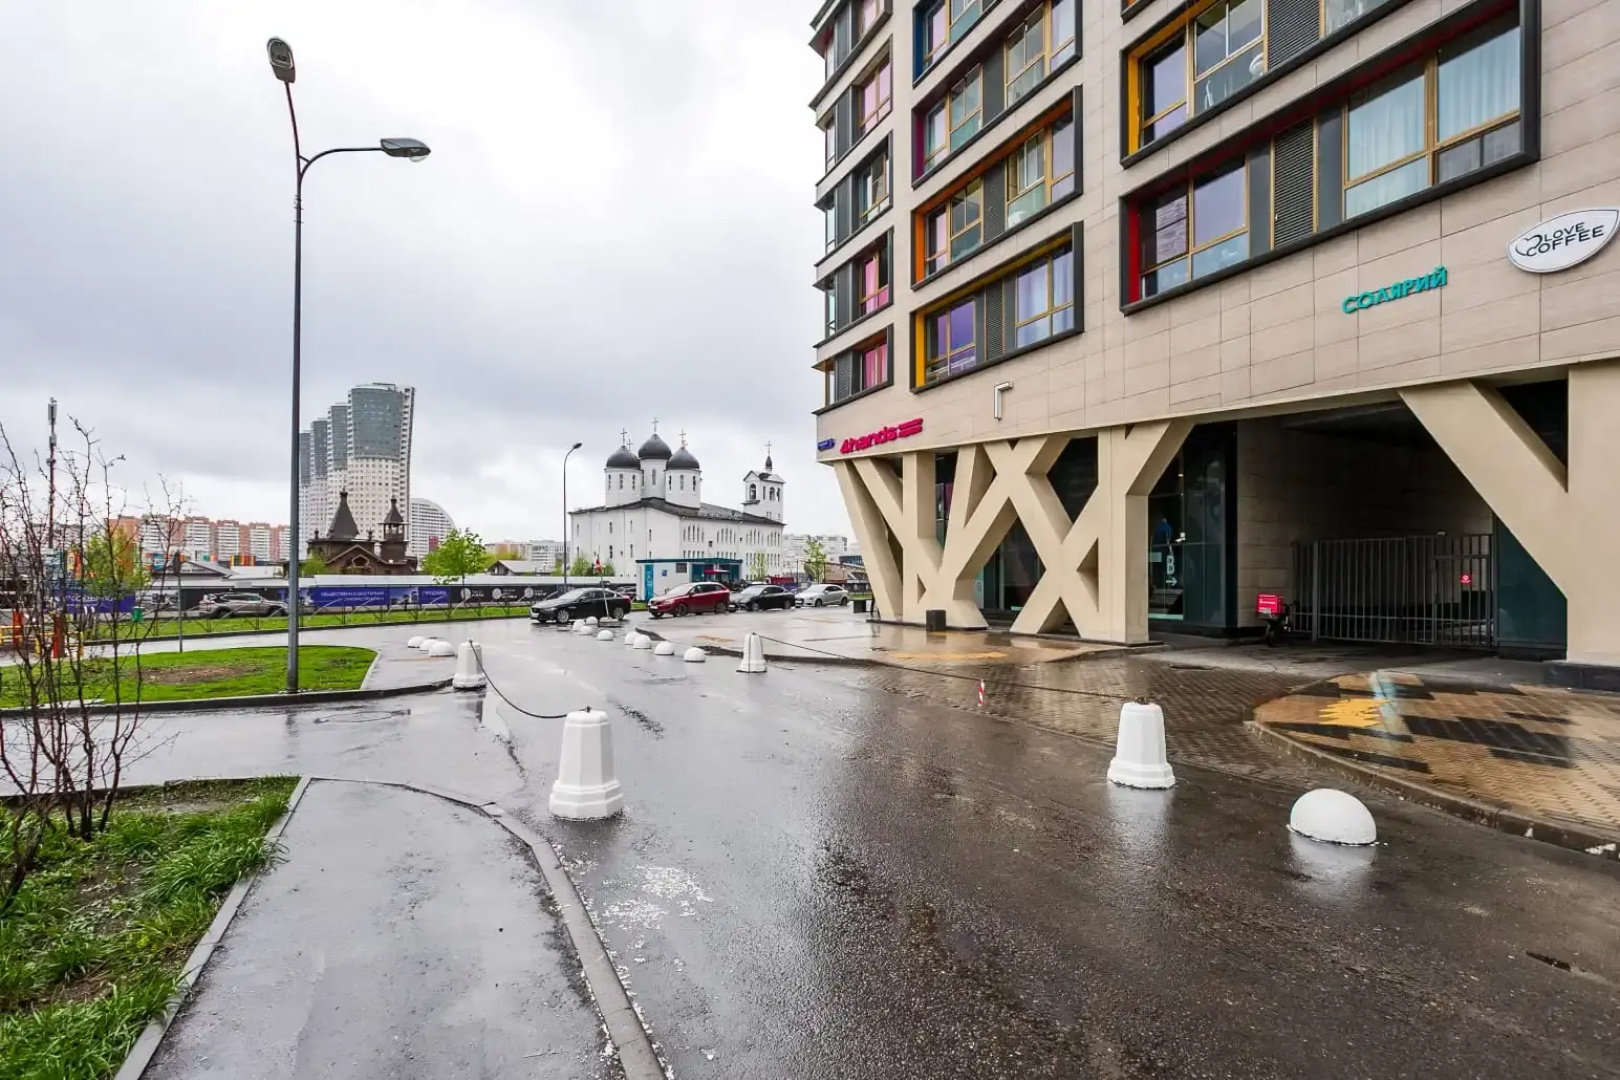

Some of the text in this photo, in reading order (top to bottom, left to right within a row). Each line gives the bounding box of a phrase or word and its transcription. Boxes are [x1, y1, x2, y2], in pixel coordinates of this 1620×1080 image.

[1526, 225, 1604, 257] COFFEE
[1544, 222, 1585, 242] LOVE
[1342, 264, 1448, 314] СОЛЯРИЙ
[840, 426, 898, 454] 4hands
